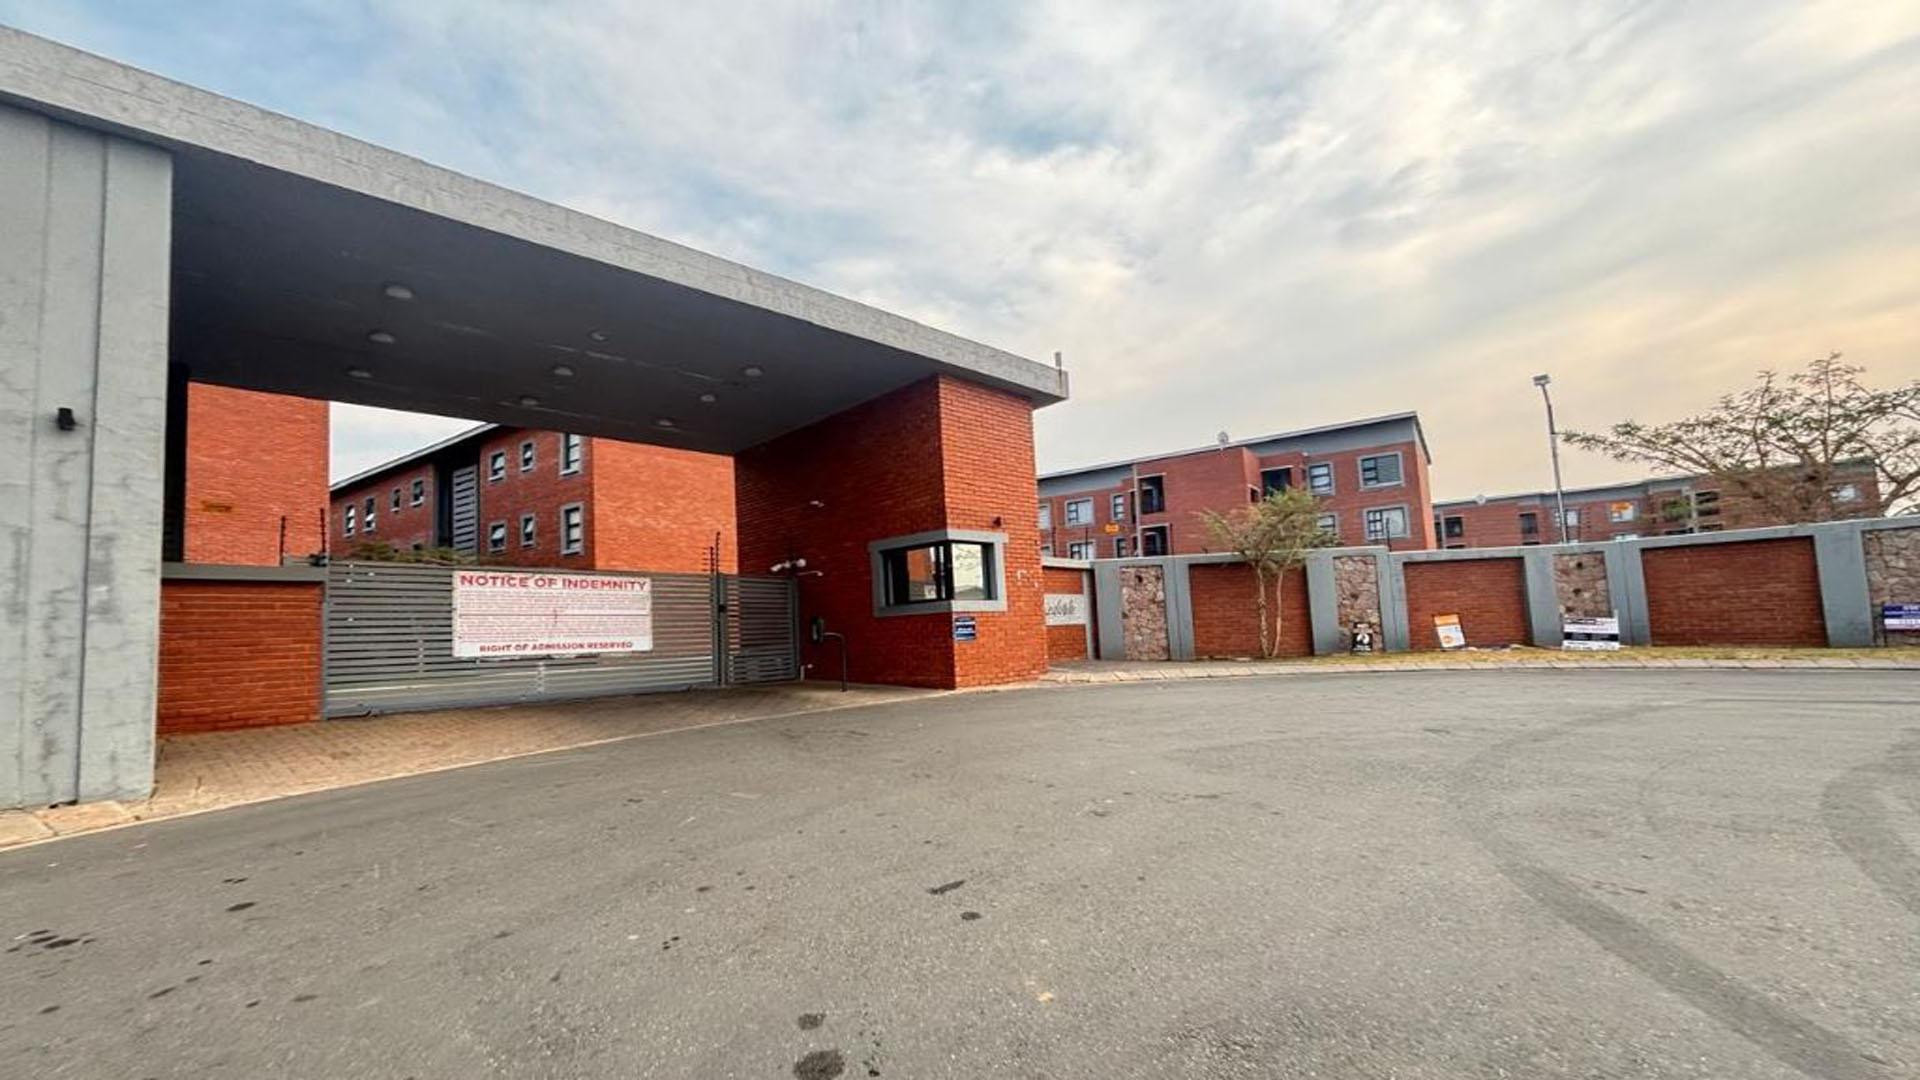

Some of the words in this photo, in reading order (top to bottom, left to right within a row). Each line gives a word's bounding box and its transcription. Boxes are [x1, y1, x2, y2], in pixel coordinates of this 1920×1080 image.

[460, 574, 529, 588] NOTICE
[534, 577, 558, 588] OF
[562, 577, 647, 591] INDEMNITY
[479, 644, 512, 653] RIGHT
[514, 643, 529, 652] OF
[531, 642, 585, 651] ADMISSION
[587, 640, 634, 650] RESERVED
